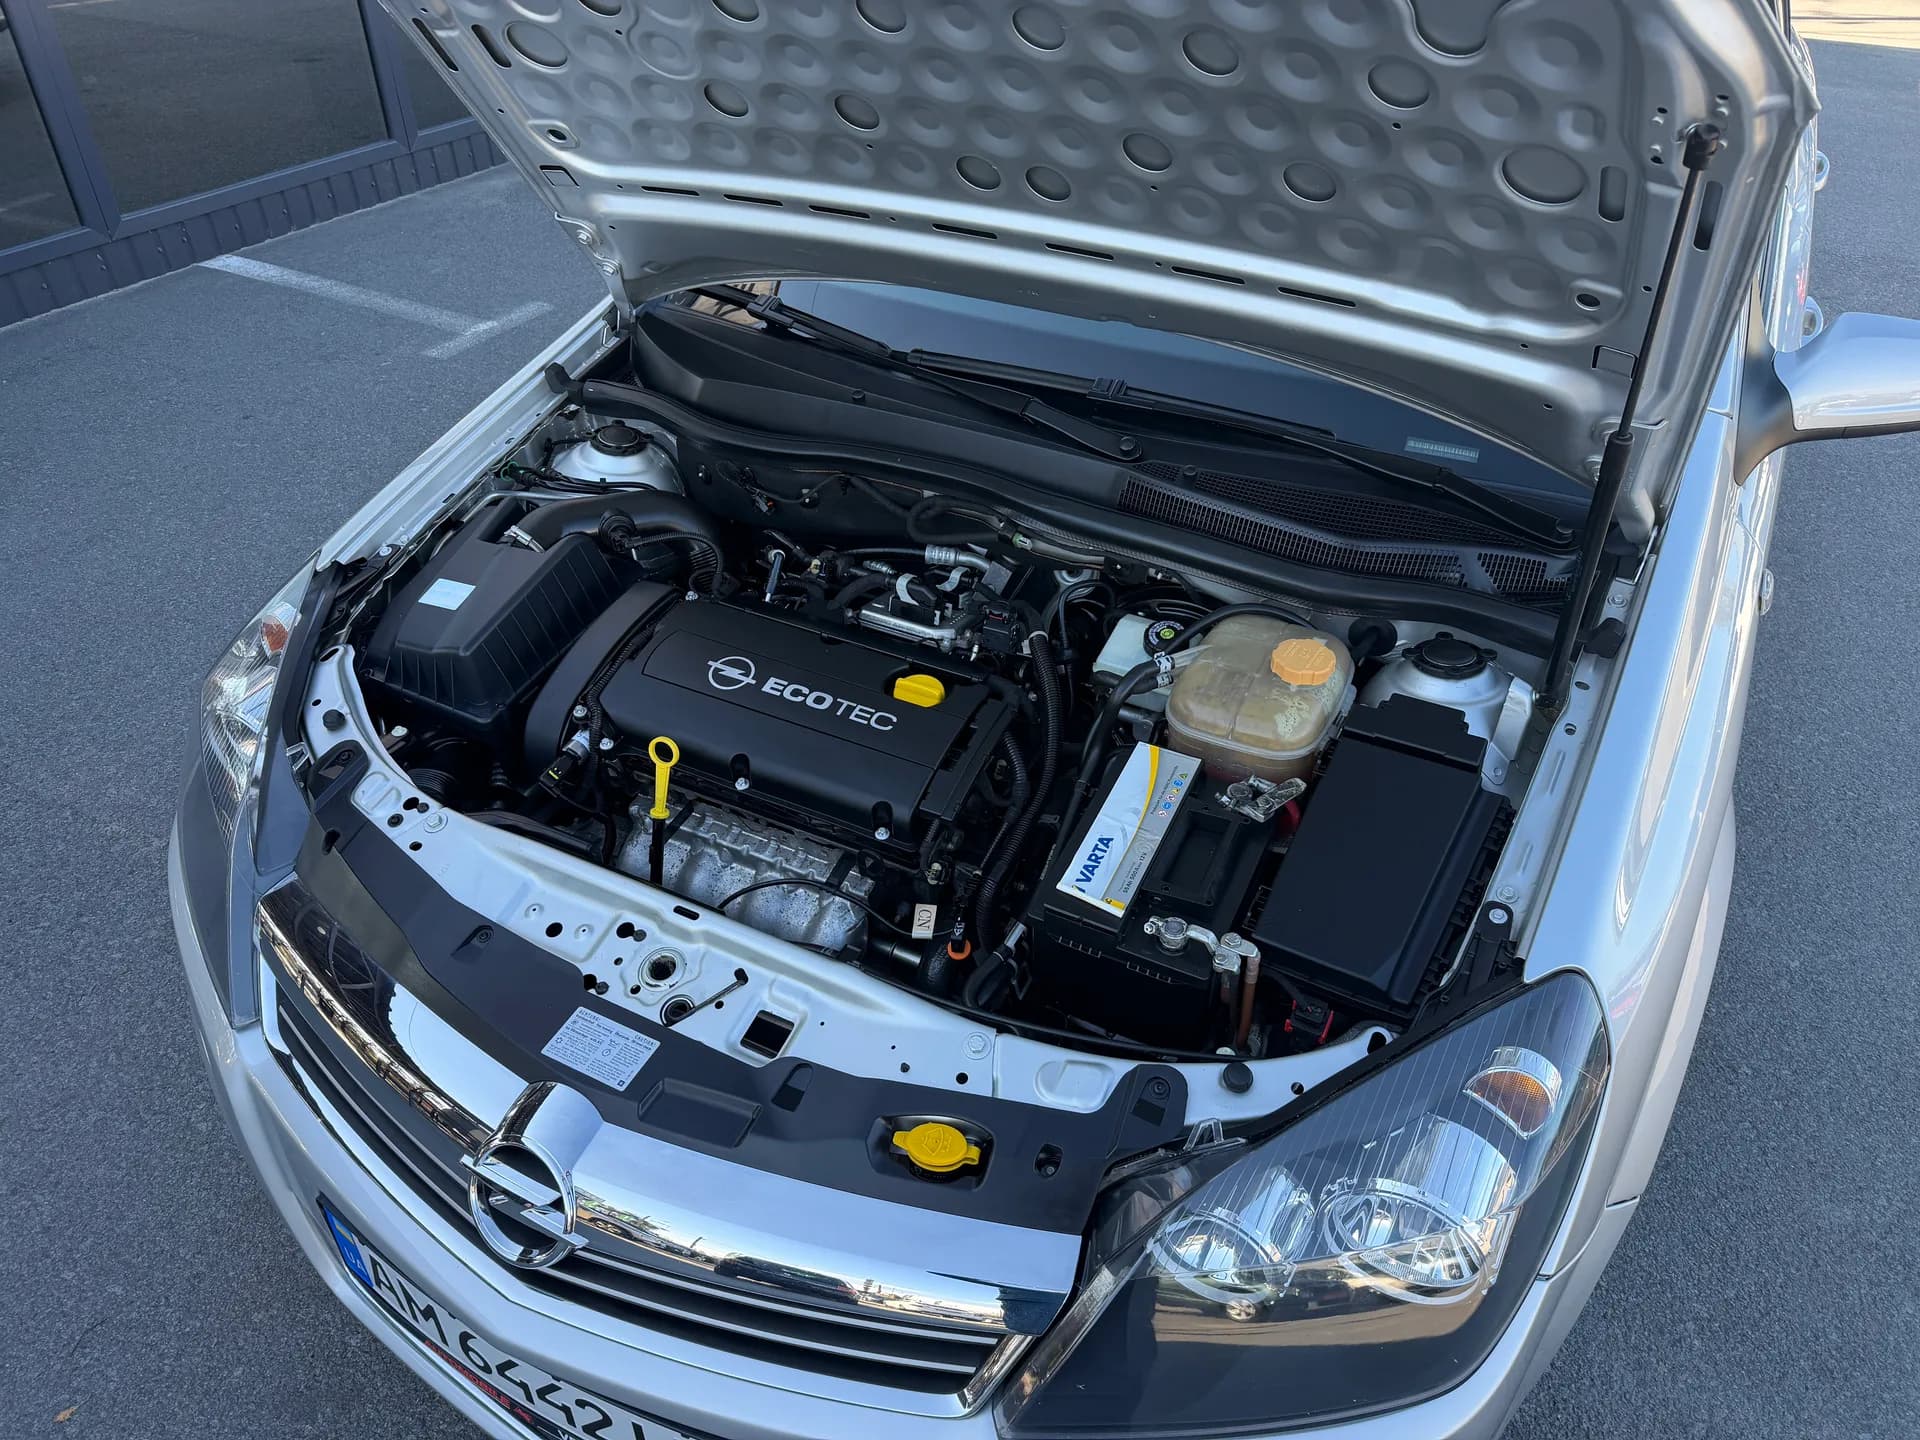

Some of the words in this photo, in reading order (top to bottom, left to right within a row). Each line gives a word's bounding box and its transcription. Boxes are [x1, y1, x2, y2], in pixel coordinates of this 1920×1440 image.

[761, 676, 898, 731] ECOTEC
[1075, 837, 1114, 882] VARTA
[368, 1253, 449, 1347] AM
[459, 1331, 613, 1440] 6442
